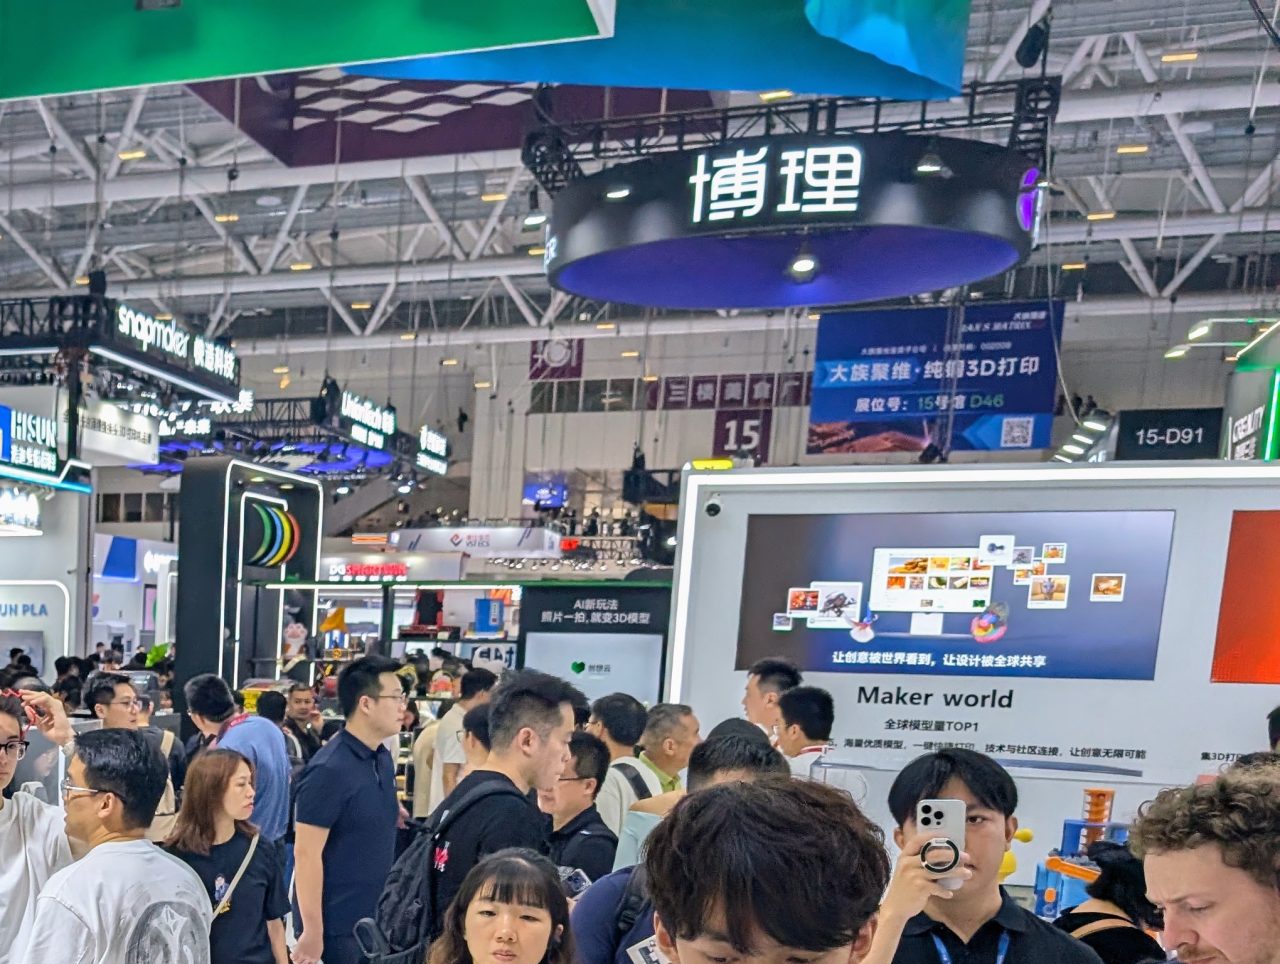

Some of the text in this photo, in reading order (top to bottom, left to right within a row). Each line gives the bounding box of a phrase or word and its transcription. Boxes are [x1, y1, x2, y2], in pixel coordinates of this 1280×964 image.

[689, 145, 862, 223] 博理
[970, 393, 1005, 408] D46
[723, 419, 761, 451] 15
[1135, 427, 1205, 446] 15-D91
[23, 603, 48, 617] PLA
[856, 686, 1014, 709] Maker world
[884, 718, 979, 733] 全球模型量TOP1
